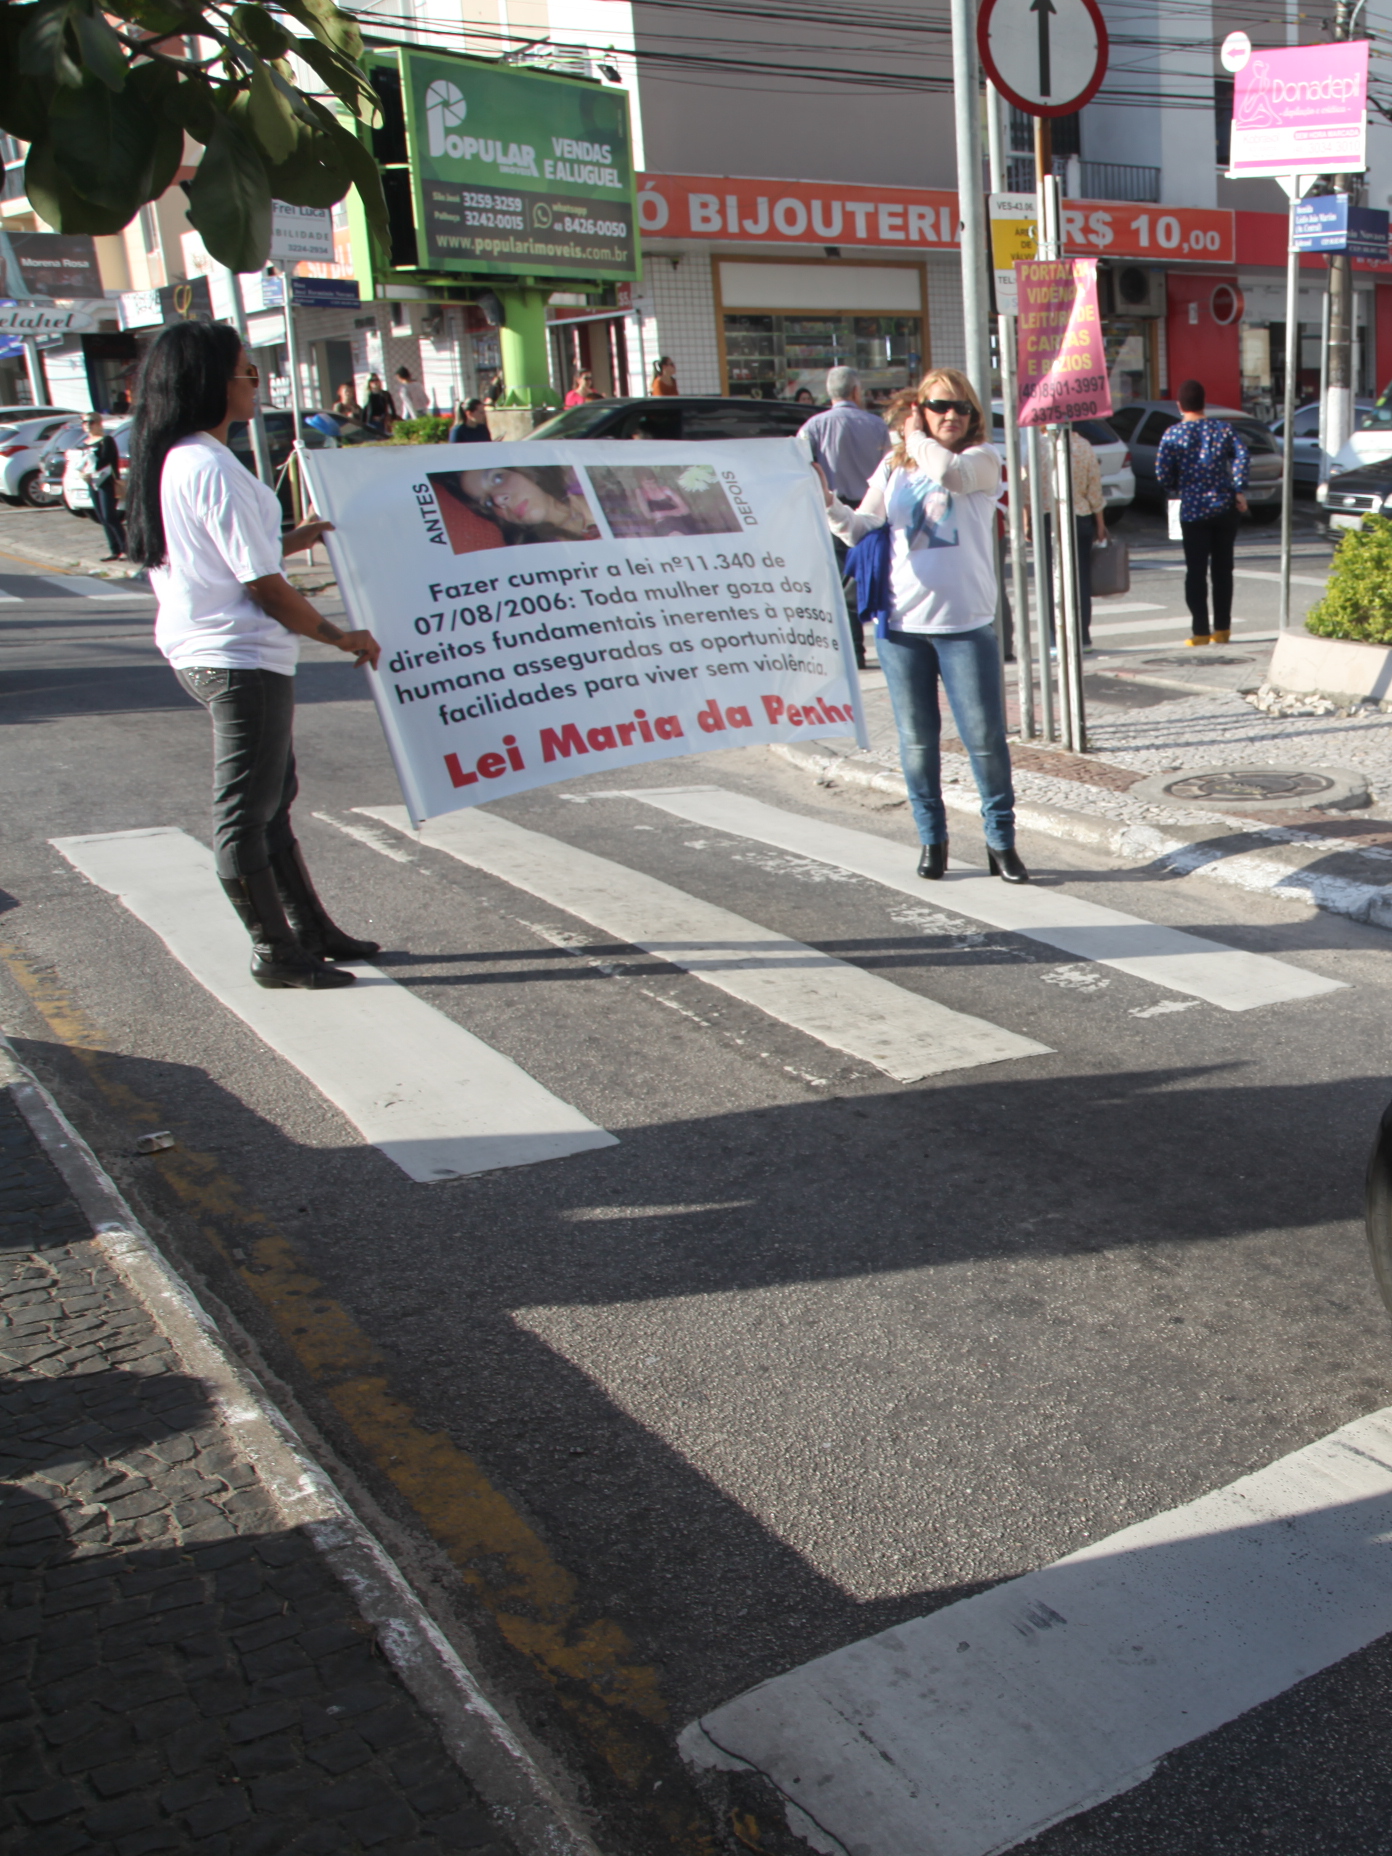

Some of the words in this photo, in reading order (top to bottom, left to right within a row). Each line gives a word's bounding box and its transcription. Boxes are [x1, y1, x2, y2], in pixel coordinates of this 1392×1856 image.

[426, 80, 540, 177] POPULAR
[552, 137, 612, 164] VENDAS
[638, 181, 669, 231] Ó
[688, 193, 961, 243] BIJOUTERI
[1130, 214, 1221, 253] 10,00
[21, 257, 61, 268] Morena
[62, 258, 89, 268] Rosa
[1042, 353, 1092, 375] BZIOS
[412, 483, 447, 545] ANTES
[721, 470, 758, 526] DEPOIS
[413, 592, 576, 636] 07/08/2006:
[580, 586, 639, 606] Toda
[644, 580, 720, 602] mulher
[727, 580, 775, 599] goza
[780, 576, 812, 594] dos
[428, 577, 499, 603] Fazer
[508, 561, 600, 587] cumprir
[607, 564, 621, 577] a
[625, 558, 655, 575] lei
[761, 551, 786, 568] de
[389, 639, 486, 674] direitos
[492, 611, 656, 651] fundamentais
[660, 605, 760, 628] inerentes
[765, 602, 778, 619] à
[783, 606, 833, 624] pessoa
[394, 666, 505, 705] humana
[513, 639, 663, 678] asseguradas
[669, 639, 694, 654] as
[701, 626, 830, 654] oportunidades
[832, 638, 839, 651] e
[438, 682, 578, 727] facilidades
[584, 672, 640, 699] para
[645, 664, 699, 685] viver
[706, 658, 749, 677] sem
[753, 653, 828, 677] violência.
[443, 734, 525, 789] Lei
[539, 709, 684, 764] Maria
[697, 699, 753, 734] da
